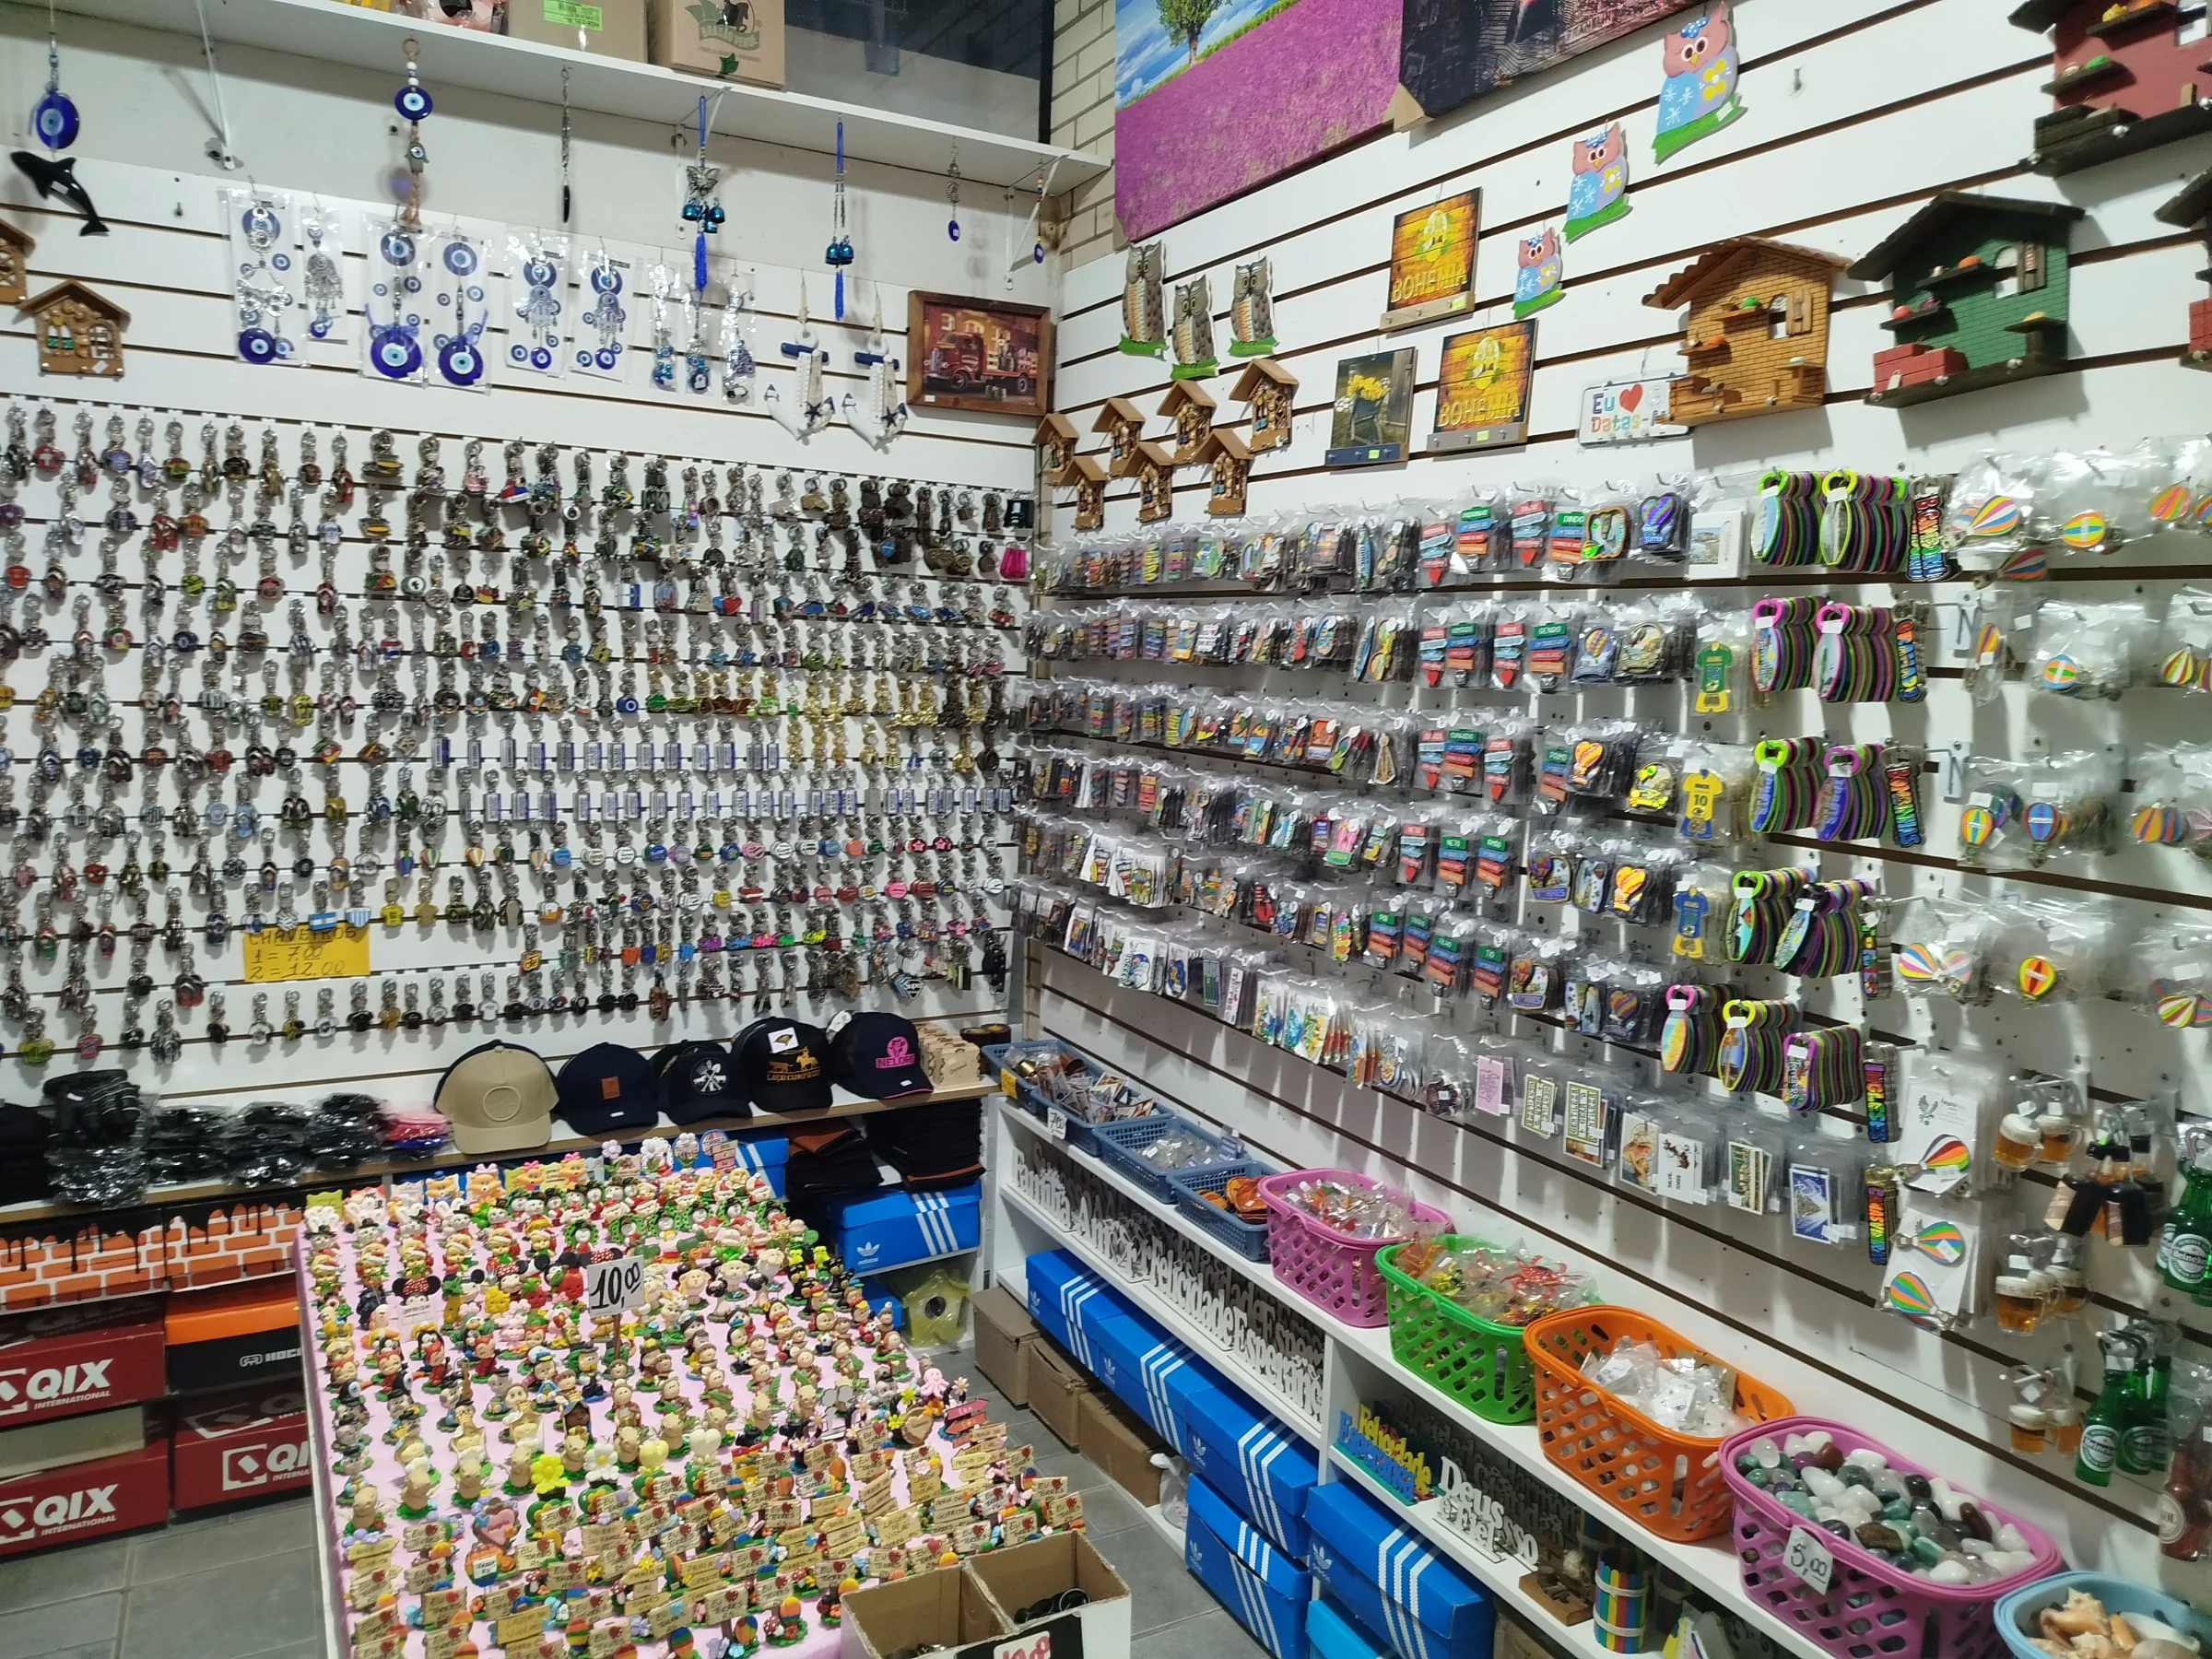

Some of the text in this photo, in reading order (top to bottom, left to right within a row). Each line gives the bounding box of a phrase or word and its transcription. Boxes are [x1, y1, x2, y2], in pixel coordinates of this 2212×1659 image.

[1593, 393, 1616, 415] Eu
[1694, 794, 1708, 806] 10
[2171, 1247, 2207, 1266] Heineke
[590, 1262, 641, 1310] 10,00
[26, 1358, 114, 1400] QIX
[34, 1390, 112, 1410] INTERNATIONAL
[266, 1441, 311, 1474] QI
[33, 1484, 119, 1526] QIX
[41, 1514, 117, 1536] INTERNATIONAL
